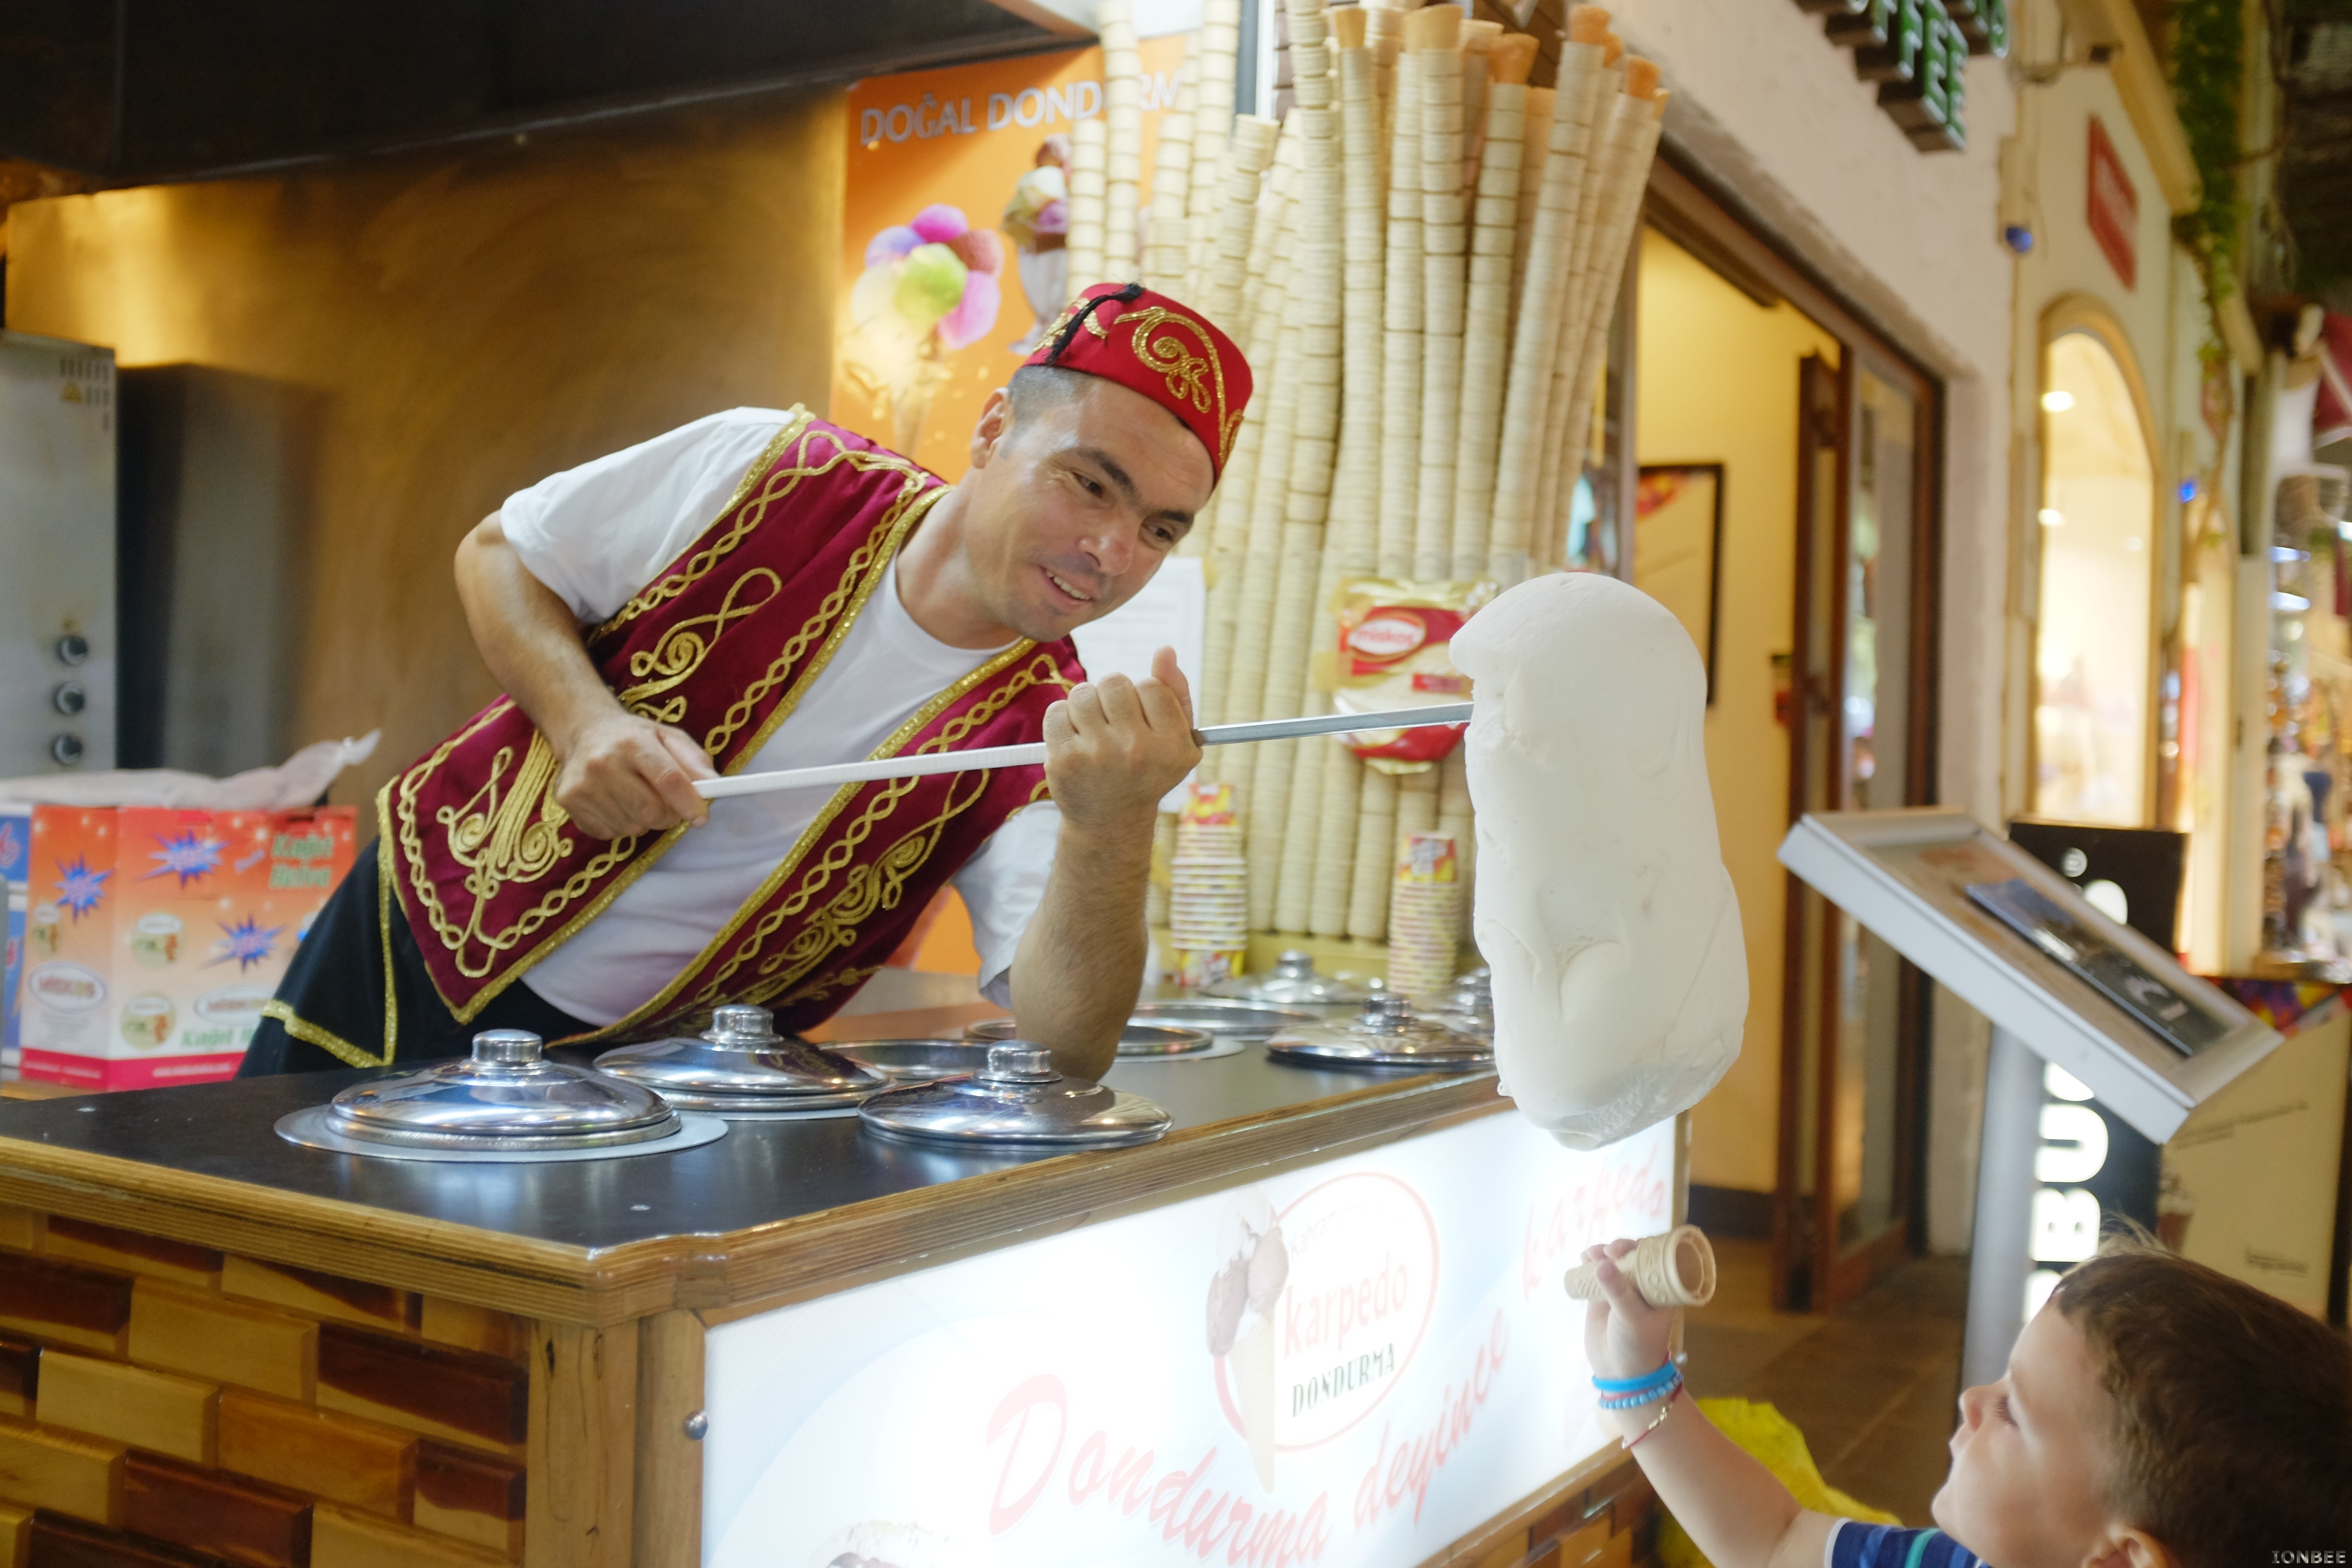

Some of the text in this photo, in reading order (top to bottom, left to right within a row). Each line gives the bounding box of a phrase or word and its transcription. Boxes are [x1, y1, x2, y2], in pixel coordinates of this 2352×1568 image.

[860, 93, 977, 145] DOĞAL
[1284, 1250, 1408, 1360] karpedo
[1291, 1343, 1395, 1418] DONDURMA
[985, 1373, 1333, 1568] Dondurma
[1354, 1308, 1509, 1531] deyince
